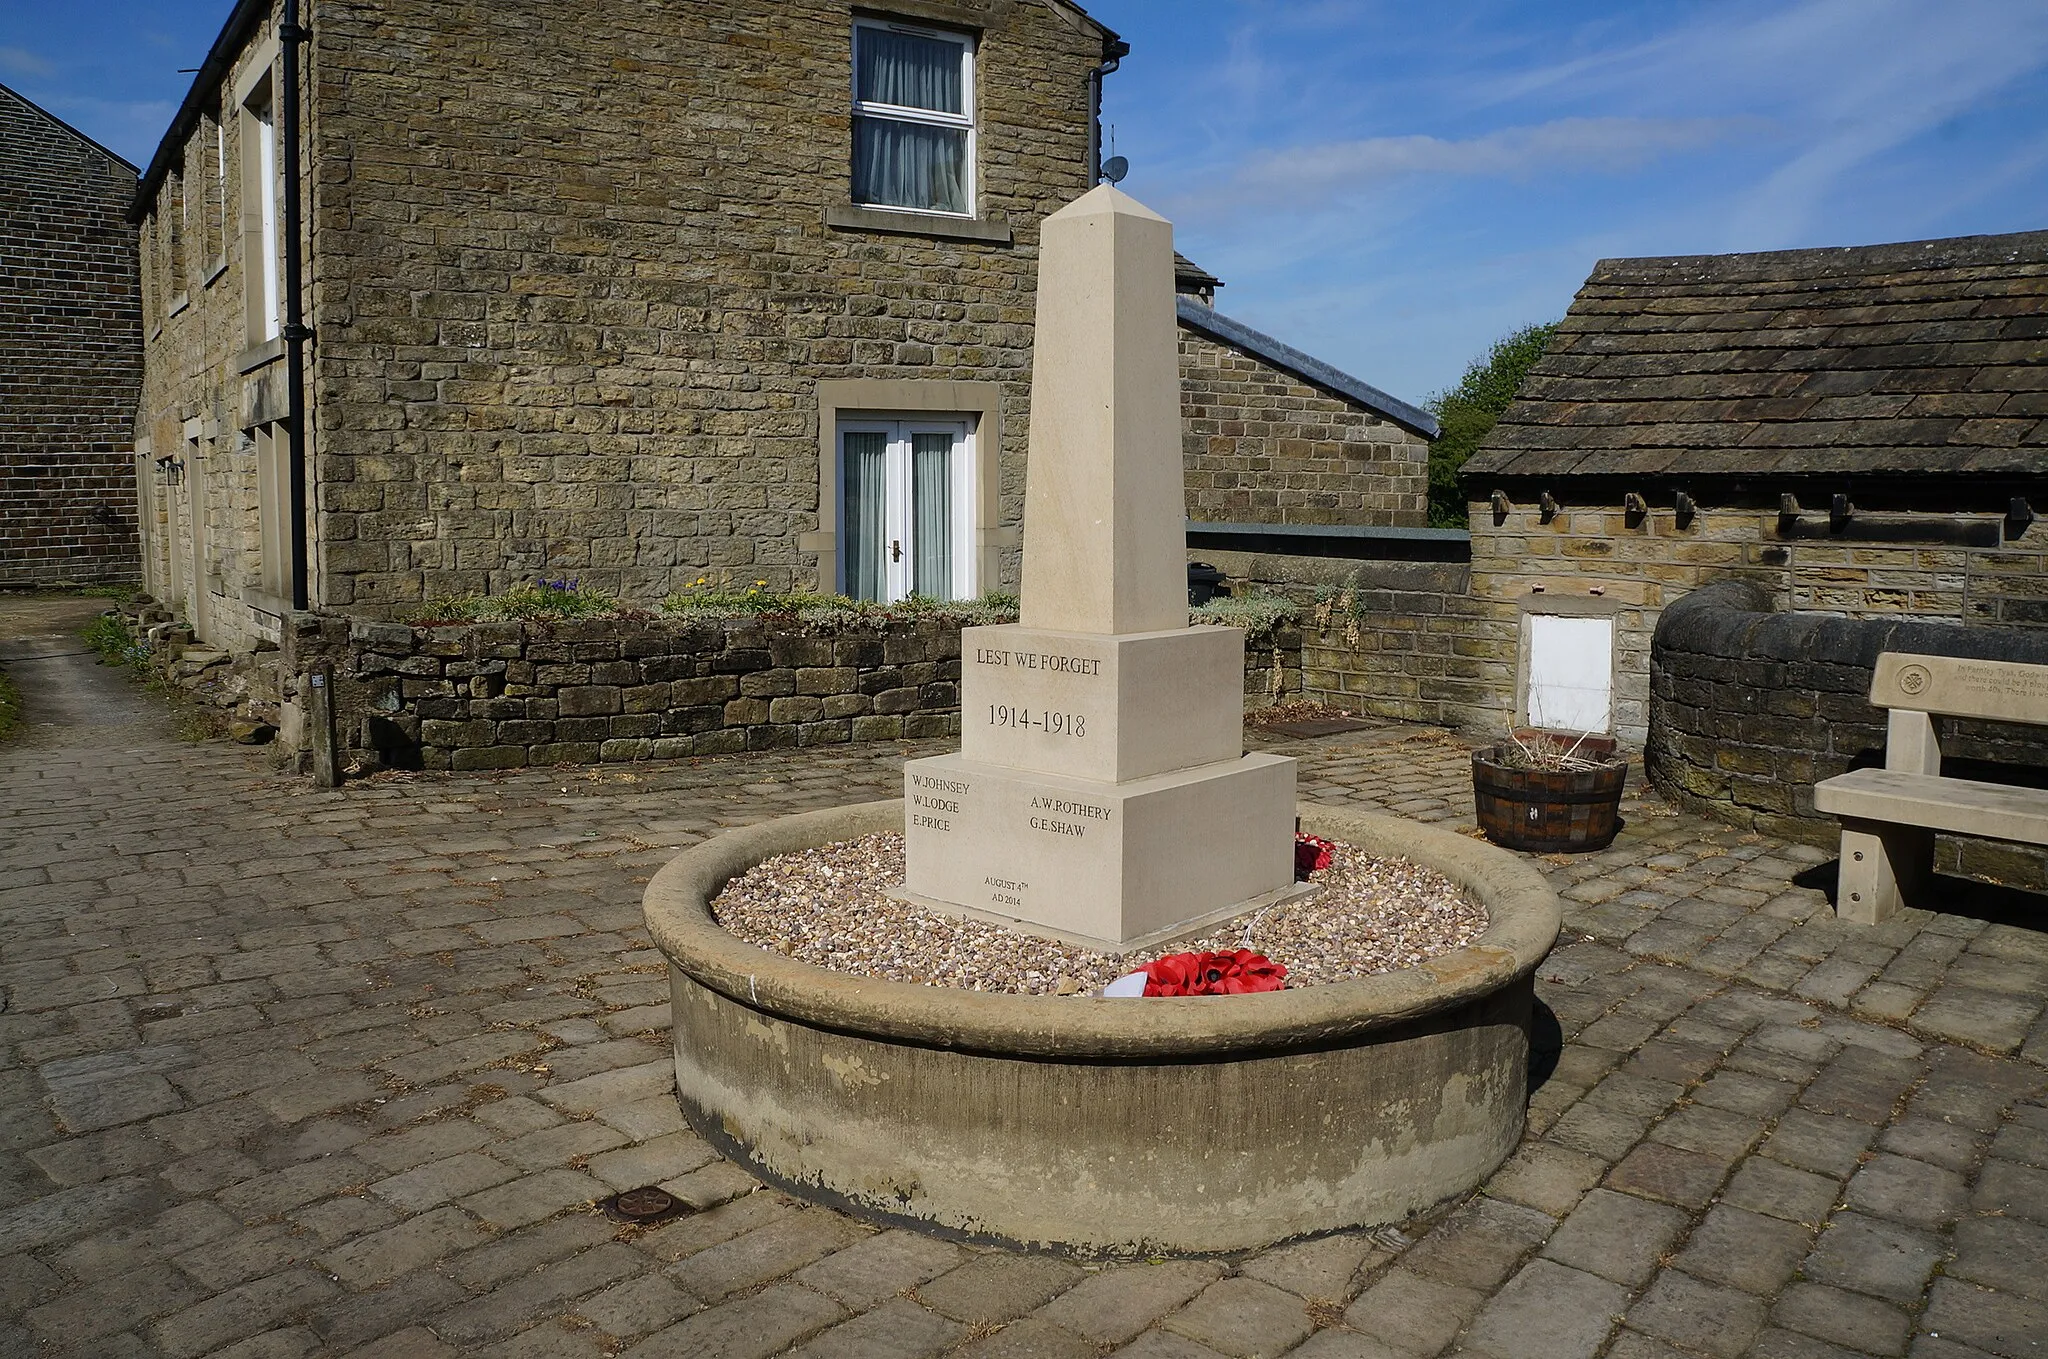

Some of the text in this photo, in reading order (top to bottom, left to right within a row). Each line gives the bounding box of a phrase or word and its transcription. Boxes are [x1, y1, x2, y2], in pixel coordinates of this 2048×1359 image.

[976, 649, 1101, 676] LEST WE FORGET
[2005, 687, 2027, 697] There
[989, 704, 1086, 738] 1914-1918
[912, 775, 970, 795] W.JOHNSEY
[913, 794, 960, 813] W.LODGE
[1030, 796, 1112, 820] A.W.ROTHERY
[913, 814, 951, 832] E.PRICE
[1030, 816, 1086, 837] G.E.SHAW
[984, 876, 1016, 891] AUGUST
[992, 893, 1021, 906] AD 2014
